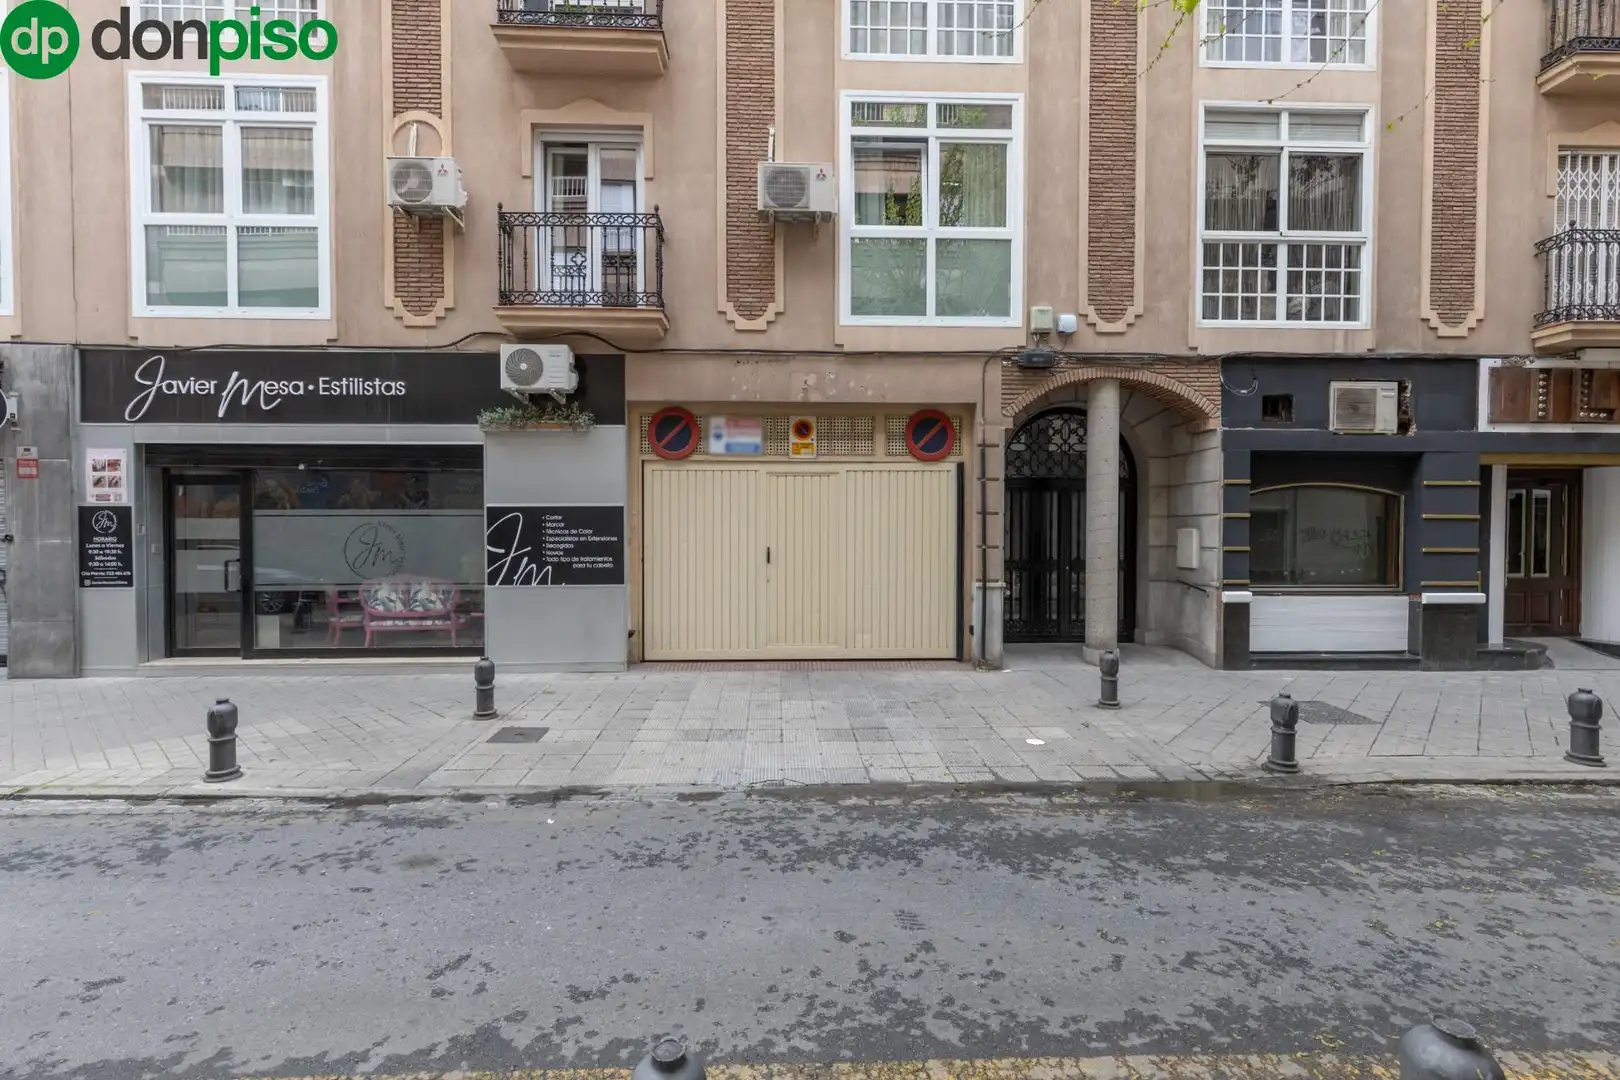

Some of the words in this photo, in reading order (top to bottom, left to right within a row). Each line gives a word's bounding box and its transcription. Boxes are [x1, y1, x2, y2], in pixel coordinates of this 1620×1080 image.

[124, 355, 217, 421] Javier
[217, 371, 304, 418] Mesa
[318, 377, 406, 396] Estilistas
